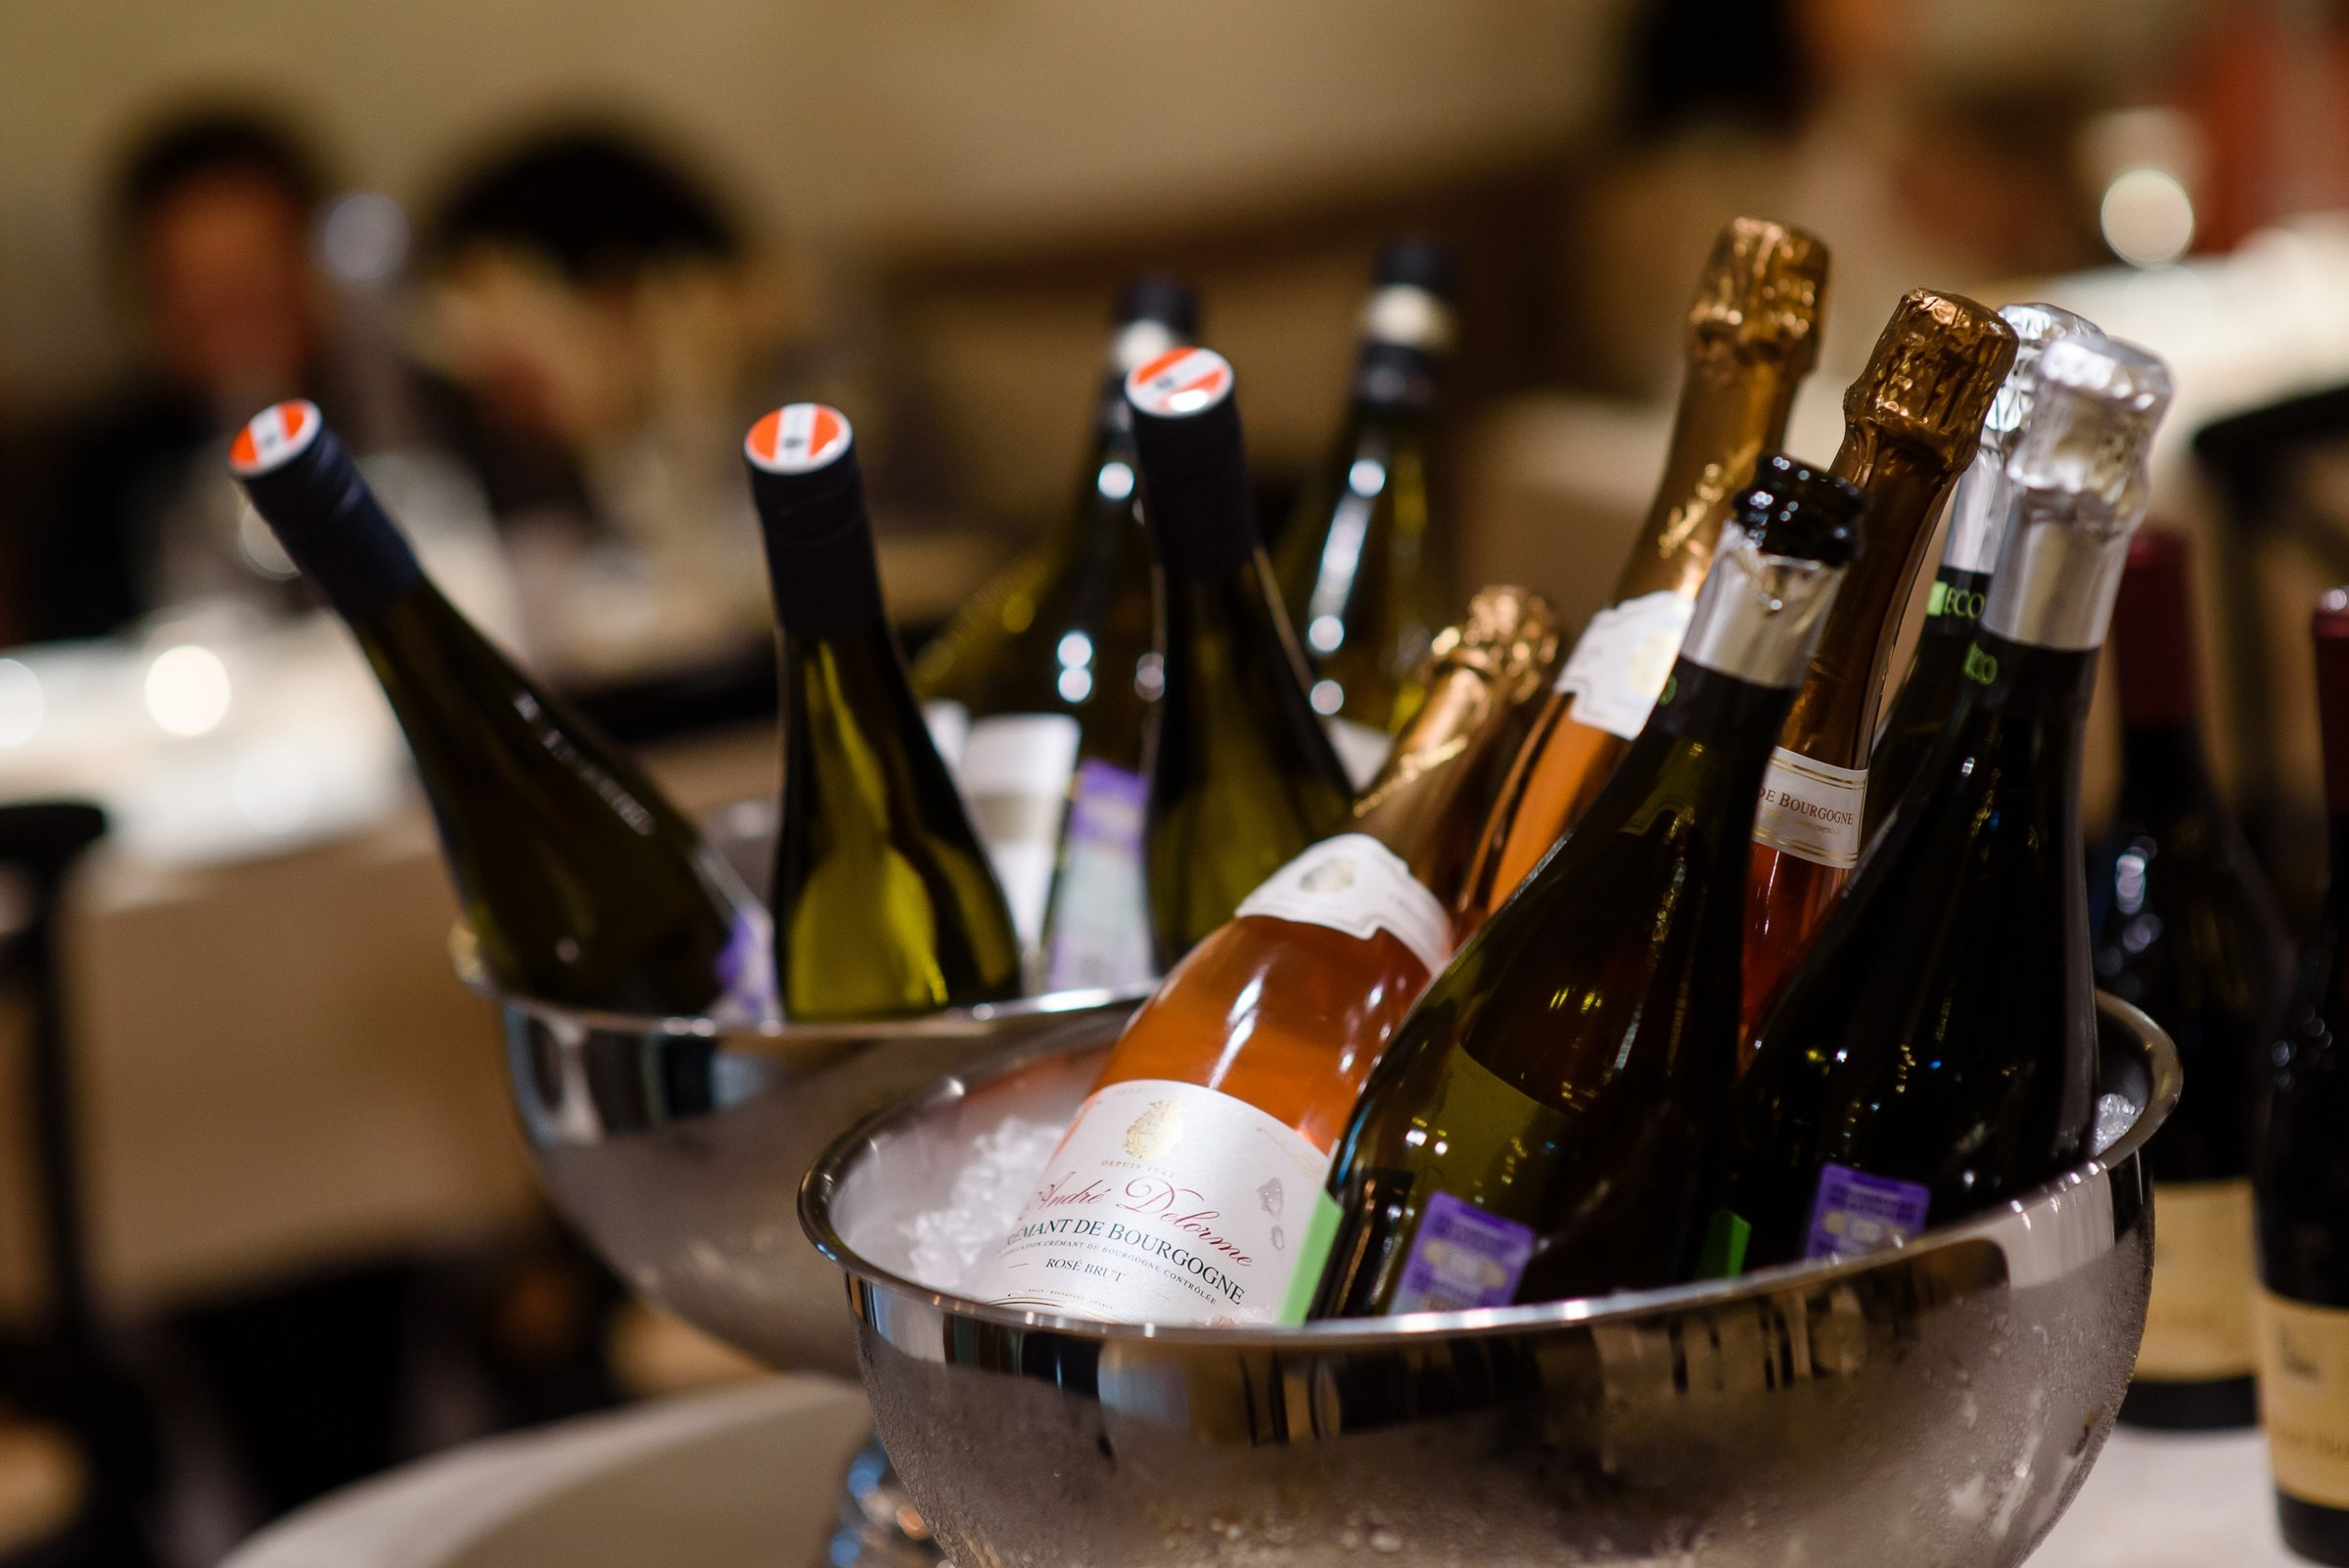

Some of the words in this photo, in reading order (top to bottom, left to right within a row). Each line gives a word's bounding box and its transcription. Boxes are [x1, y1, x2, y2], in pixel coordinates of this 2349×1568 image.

[1944, 586, 1985, 621] ECO
[1778, 792, 1855, 825] BOURGOGNE
[1100, 1160, 1141, 1171] DEPUIS
[1026, 1171, 1112, 1216] André
[1116, 1176, 1253, 1267] Delorme
[1043, 1238, 1085, 1249] CRÉMANT
[1102, 1246, 1162, 1272] BOURGOGNE
[1163, 1269, 1218, 1306] CONTRÔLÉE
[1045, 1258, 1082, 1271] ROSÉ
[1083, 1263, 1127, 1283] BRUT
[1073, 1219, 1105, 1236] DE
[1108, 1222, 1245, 1306] BOURGOGNE
